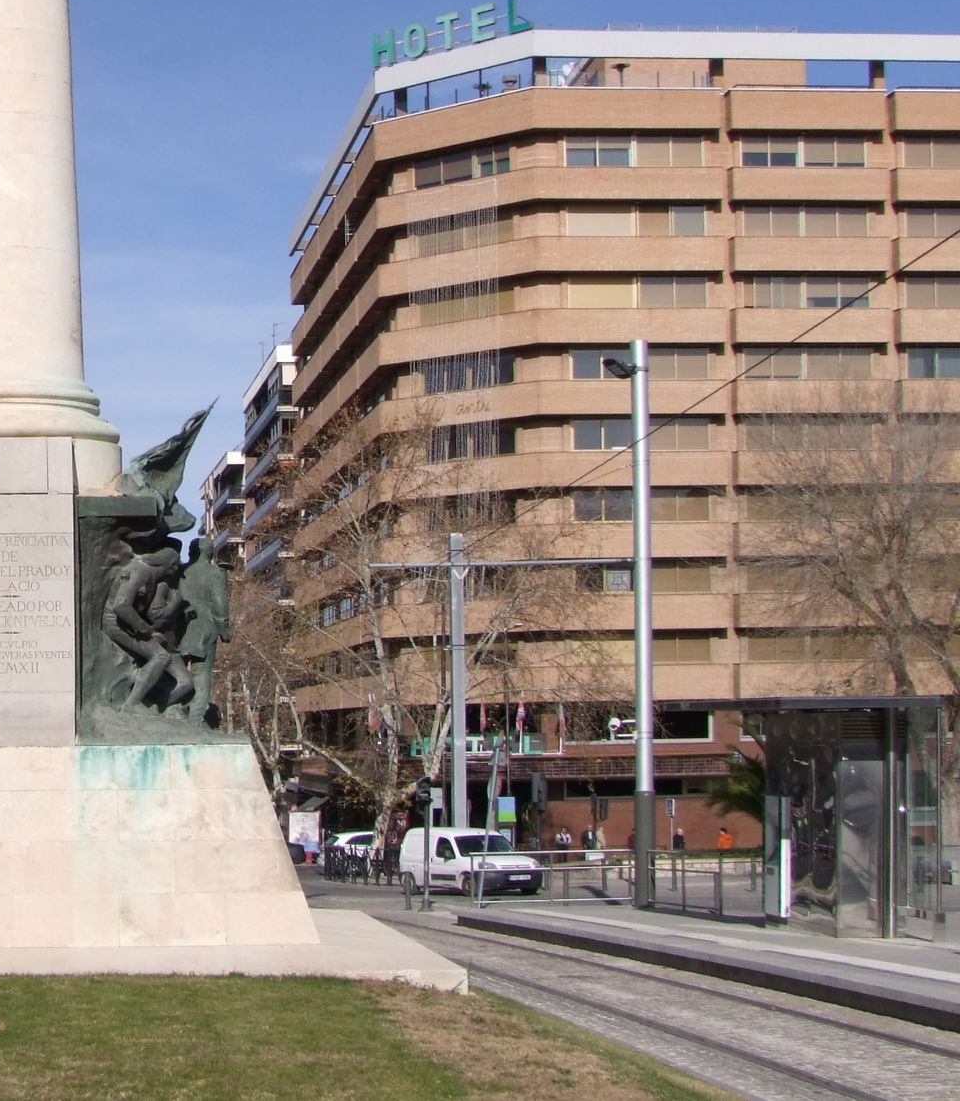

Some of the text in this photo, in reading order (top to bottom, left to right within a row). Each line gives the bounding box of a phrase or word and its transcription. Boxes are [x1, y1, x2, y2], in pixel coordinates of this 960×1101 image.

[1, 551, 18, 562] DE
[18, 565, 62, 577] PRADO
[38, 601, 62, 612] POR
